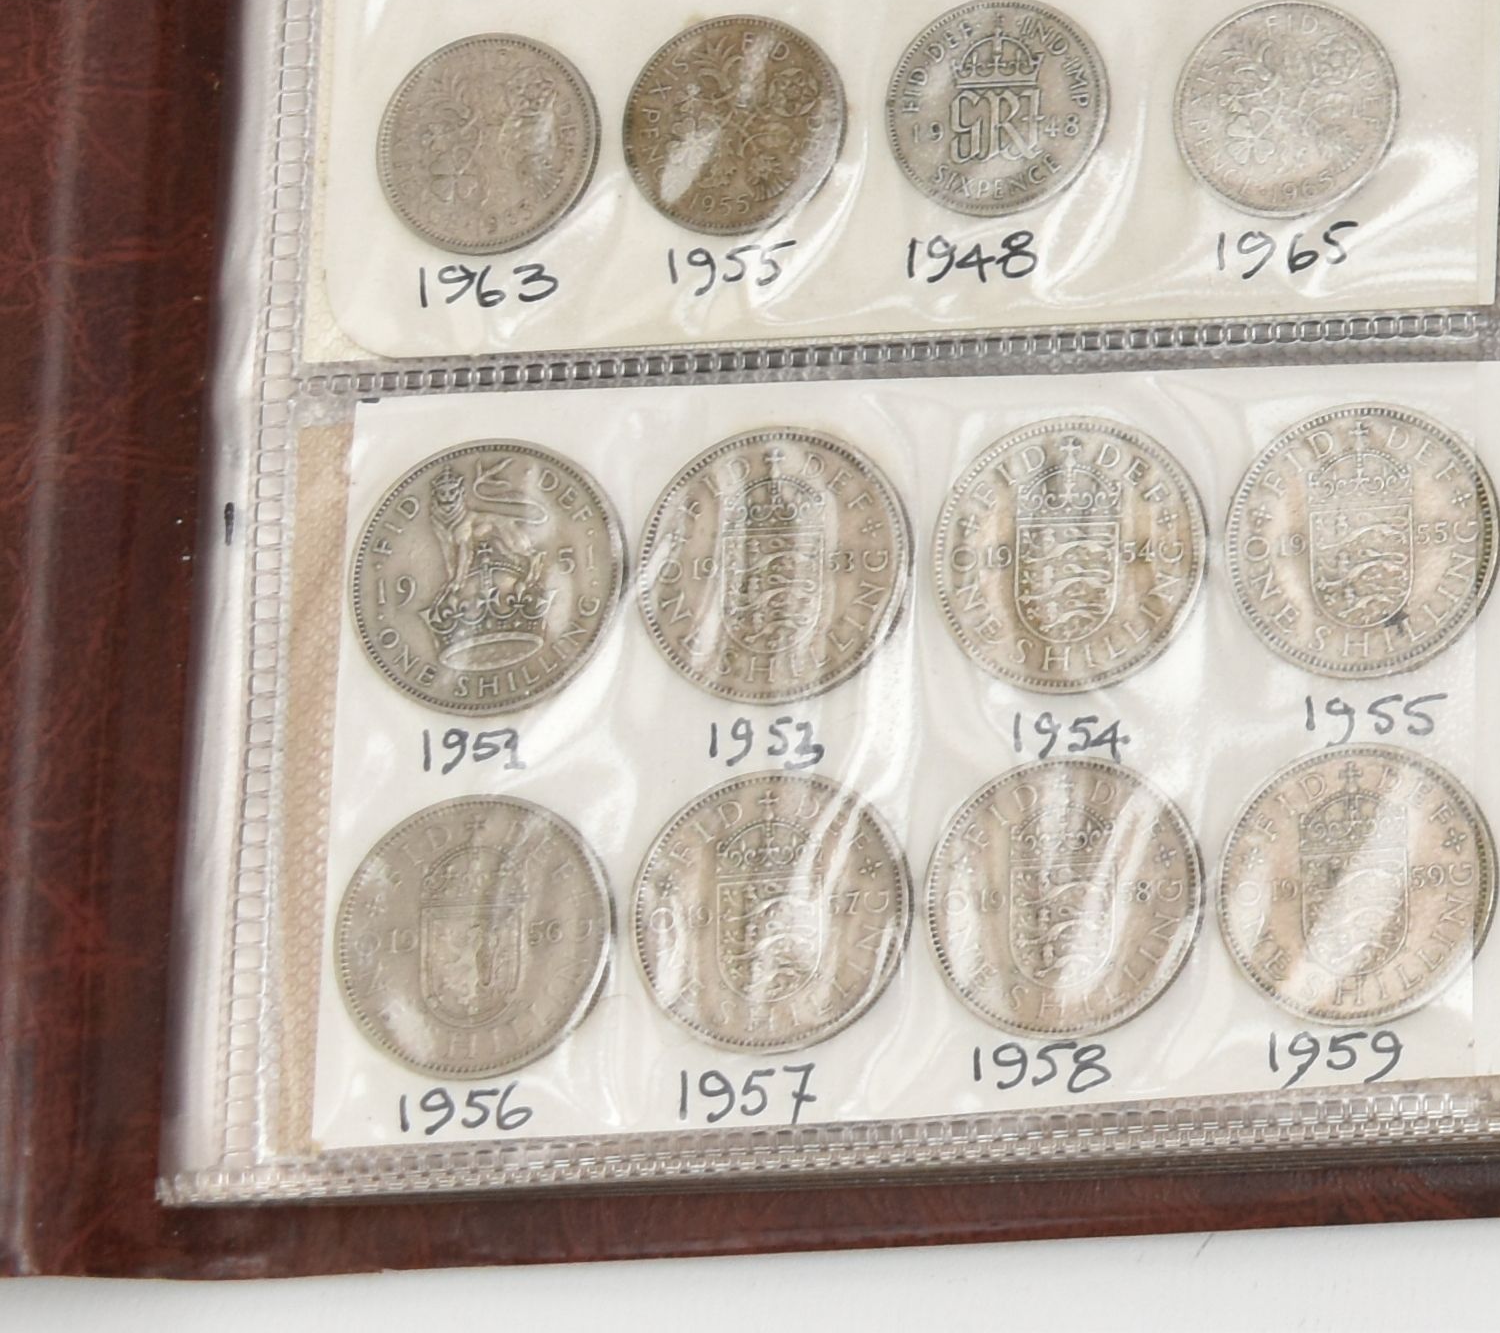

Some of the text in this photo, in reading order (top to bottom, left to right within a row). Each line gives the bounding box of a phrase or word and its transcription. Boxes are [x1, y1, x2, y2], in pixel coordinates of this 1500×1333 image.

[668, 240, 796, 296] 1955
[907, 231, 1037, 283] 1948
[1218, 221, 1358, 279] 1965
[420, 264, 558, 308] 1963
[1014, 712, 1129, 764] 1954
[1306, 694, 1446, 734] 1955
[974, 1039, 1111, 1093] 1958
[1270, 1031, 1403, 1091] 1959
[400, 1085, 532, 1135] 1956
[680, 1063, 816, 1129] 1957
